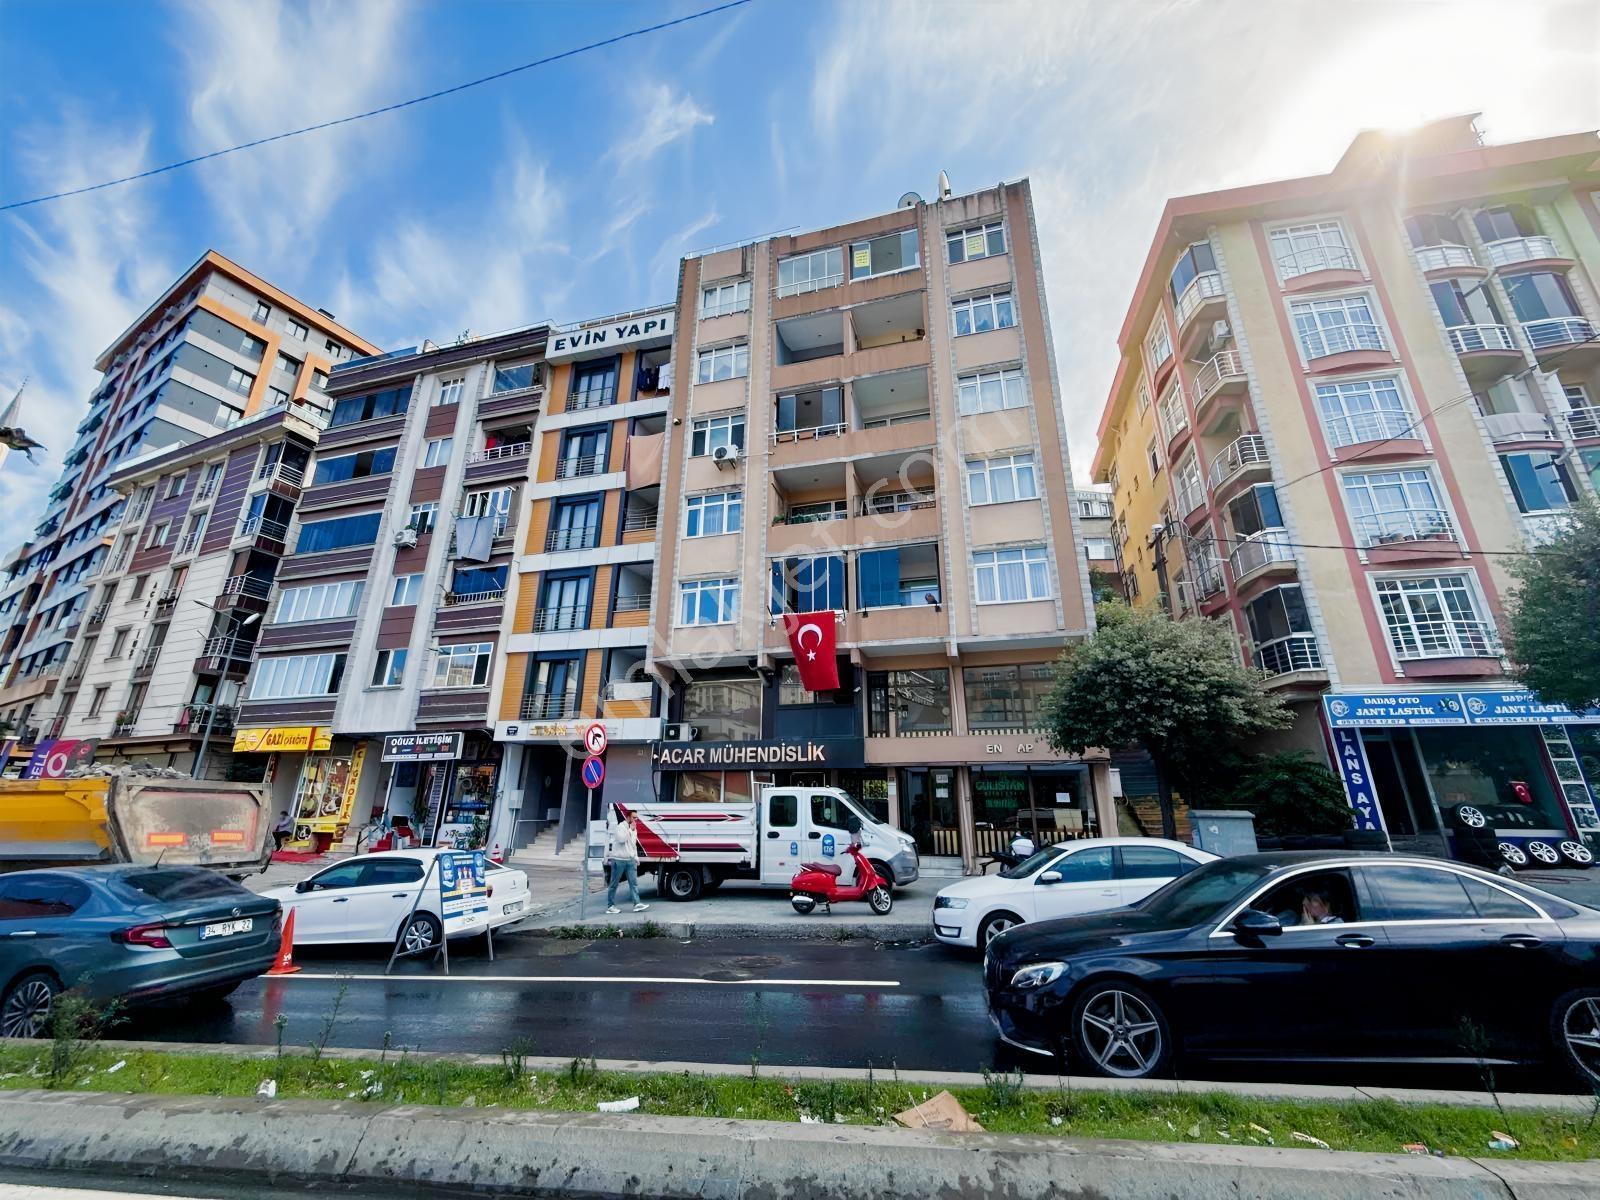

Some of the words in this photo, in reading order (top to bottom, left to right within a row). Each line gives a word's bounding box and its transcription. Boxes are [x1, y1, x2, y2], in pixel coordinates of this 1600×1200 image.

[554, 330, 607, 351] EVİN
[615, 318, 667, 339] YAPI
[1363, 697, 1396, 706] DADAŞ
[1356, 708, 1387, 716] JANT
[1389, 705, 1435, 715] LASTİK
[1494, 705, 1527, 714] JANT
[660, 748, 705, 764] ACAR
[709, 741, 826, 764] MÜHENDİSLİK
[986, 744, 1003, 754] EN
[1017, 743, 1034, 753] AP
[28, 750, 50, 779] ELL
[206, 926, 216, 936] 34
